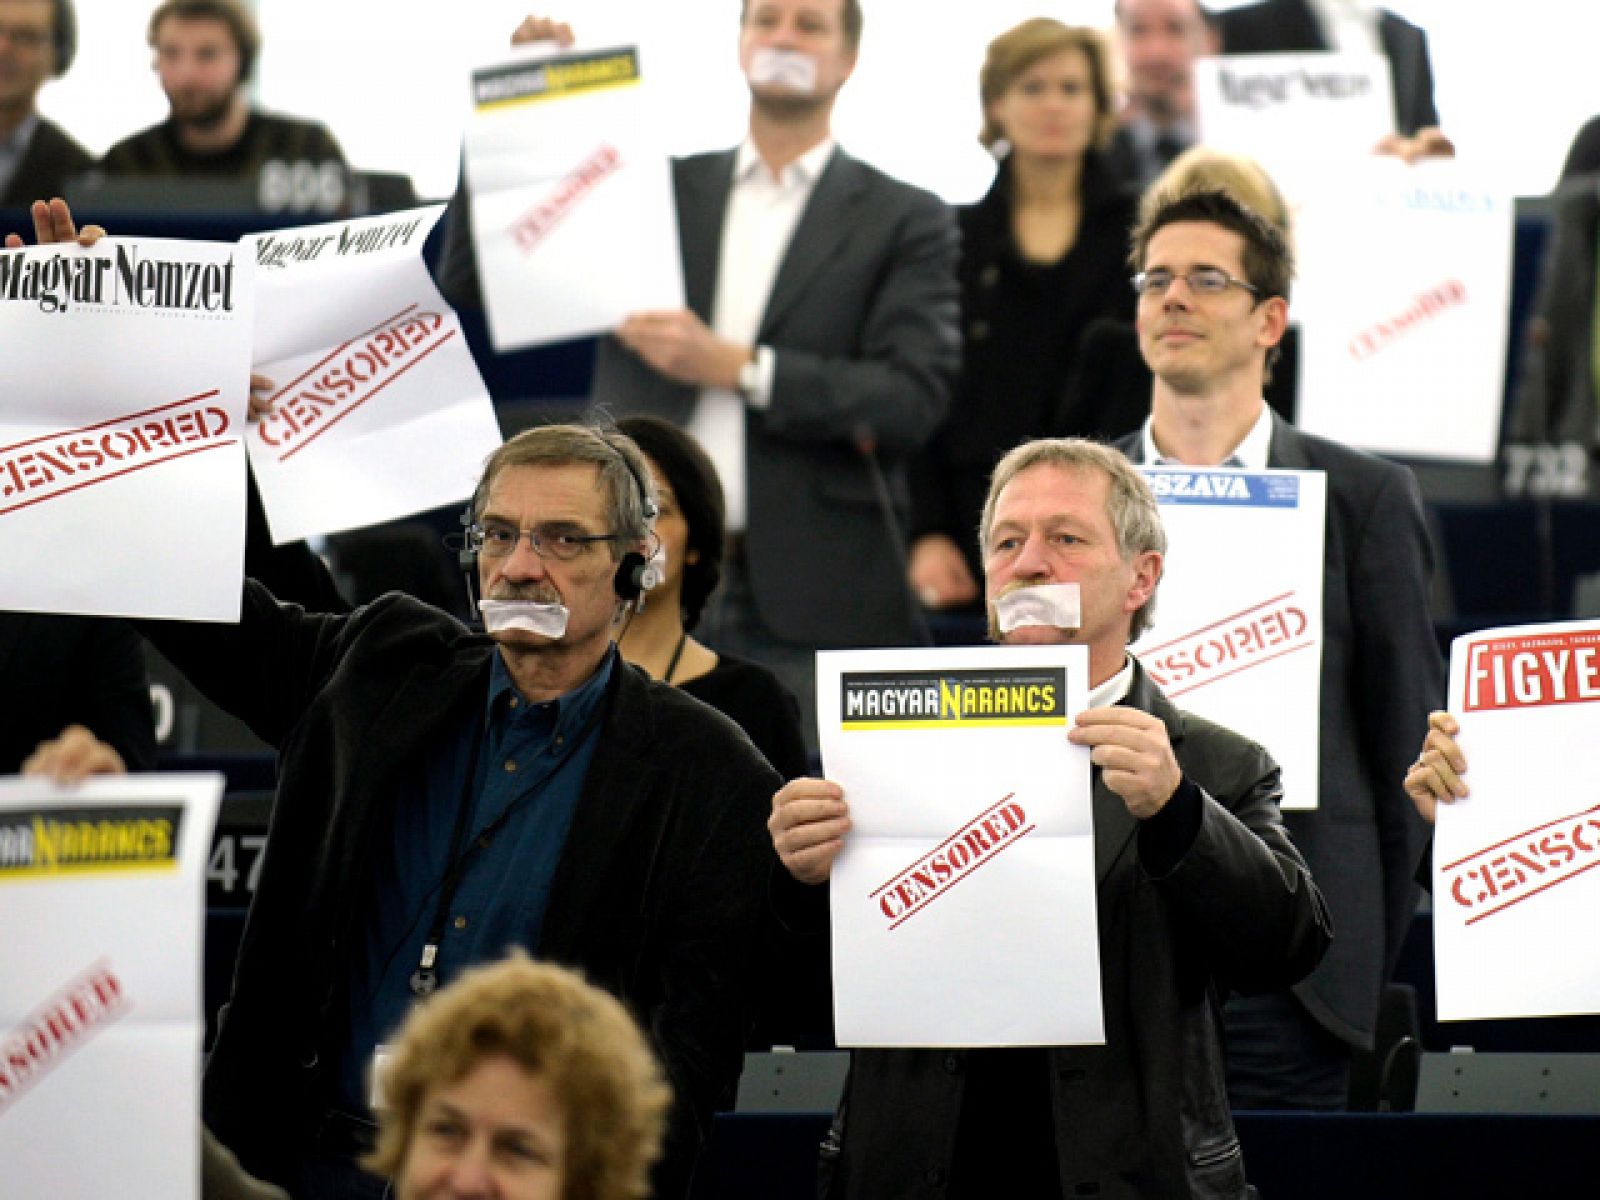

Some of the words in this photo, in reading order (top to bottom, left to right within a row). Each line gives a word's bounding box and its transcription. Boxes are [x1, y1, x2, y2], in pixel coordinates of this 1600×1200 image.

[0, 252, 112, 312] Magyar
[112, 244, 236, 312] Nemzet
[258, 311, 442, 446] CENSORED
[1468, 644, 1600, 708] FIGYE
[879, 803, 1026, 919] CENSORED
